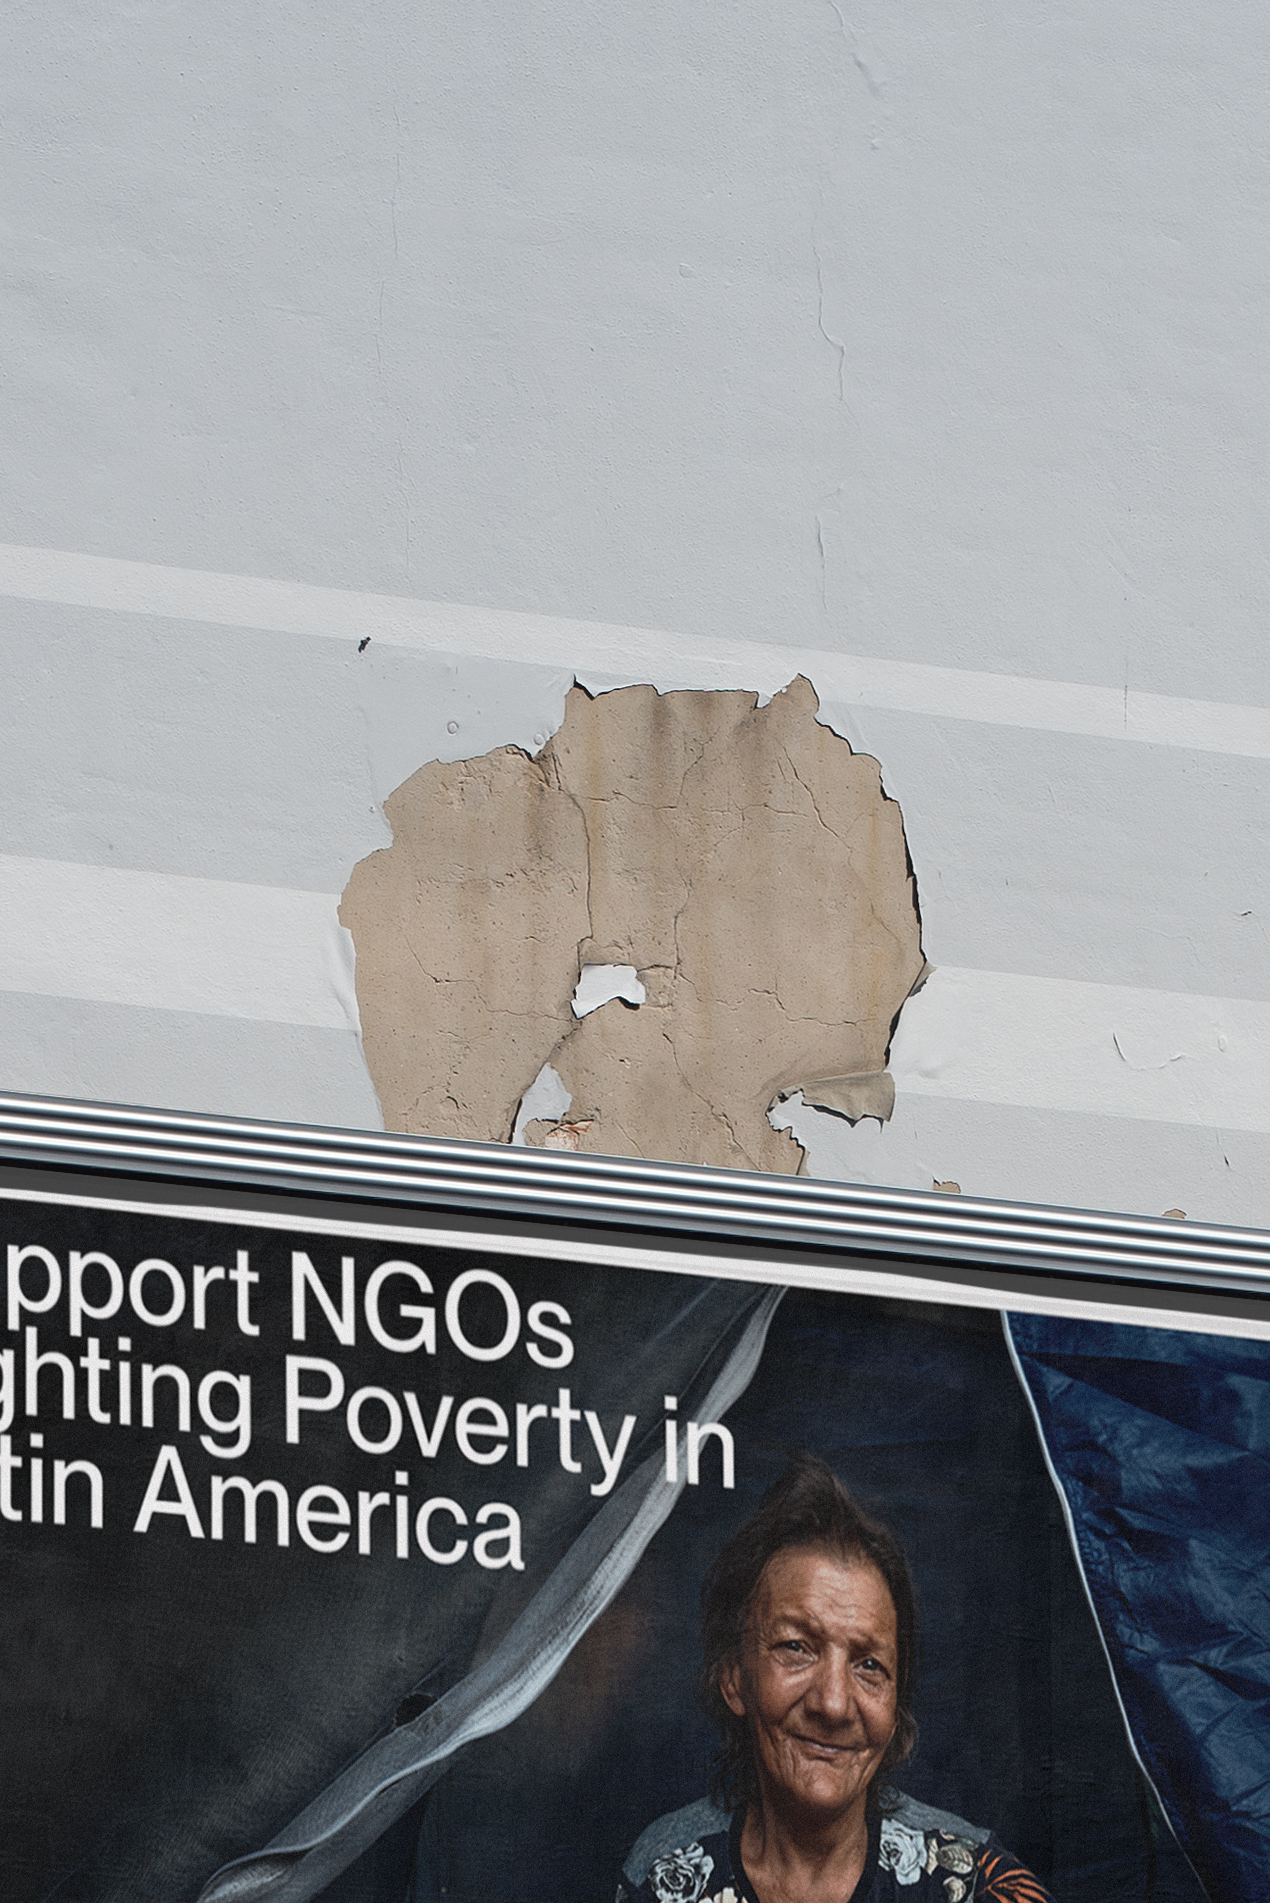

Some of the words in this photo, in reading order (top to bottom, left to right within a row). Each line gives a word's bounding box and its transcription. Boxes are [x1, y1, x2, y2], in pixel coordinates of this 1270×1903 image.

[293, 1250, 576, 1370] NGOs
[285, 1354, 636, 1498] Poverty
[663, 1395, 736, 1490] in
[132, 1444, 527, 1572] America
